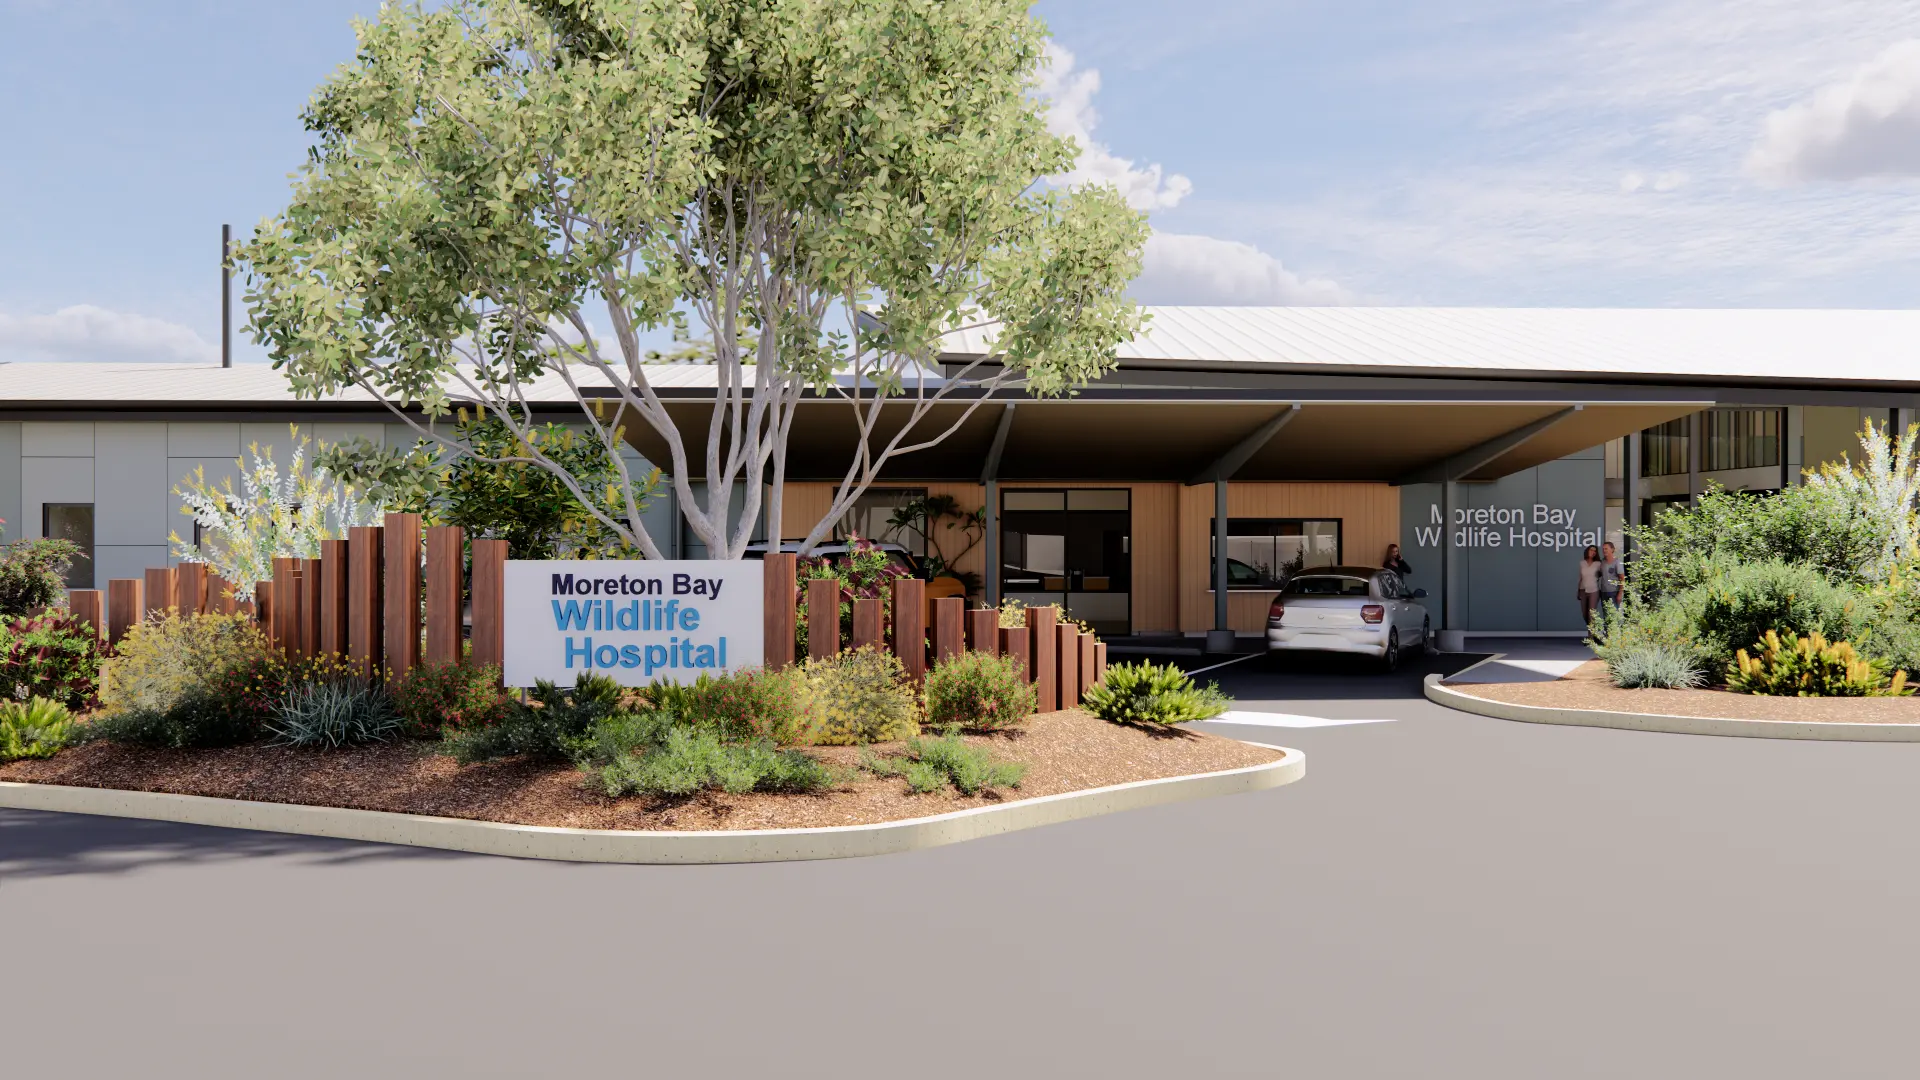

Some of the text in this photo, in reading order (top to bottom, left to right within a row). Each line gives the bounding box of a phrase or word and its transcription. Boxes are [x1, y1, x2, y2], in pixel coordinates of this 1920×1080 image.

[1431, 504, 1576, 529] Moreton Bay
[1415, 526, 1601, 552] Wdlife Hospital
[551, 573, 723, 600] Moreton Bay
[551, 599, 700, 631] Wildlife
[565, 636, 726, 676] Hospital
